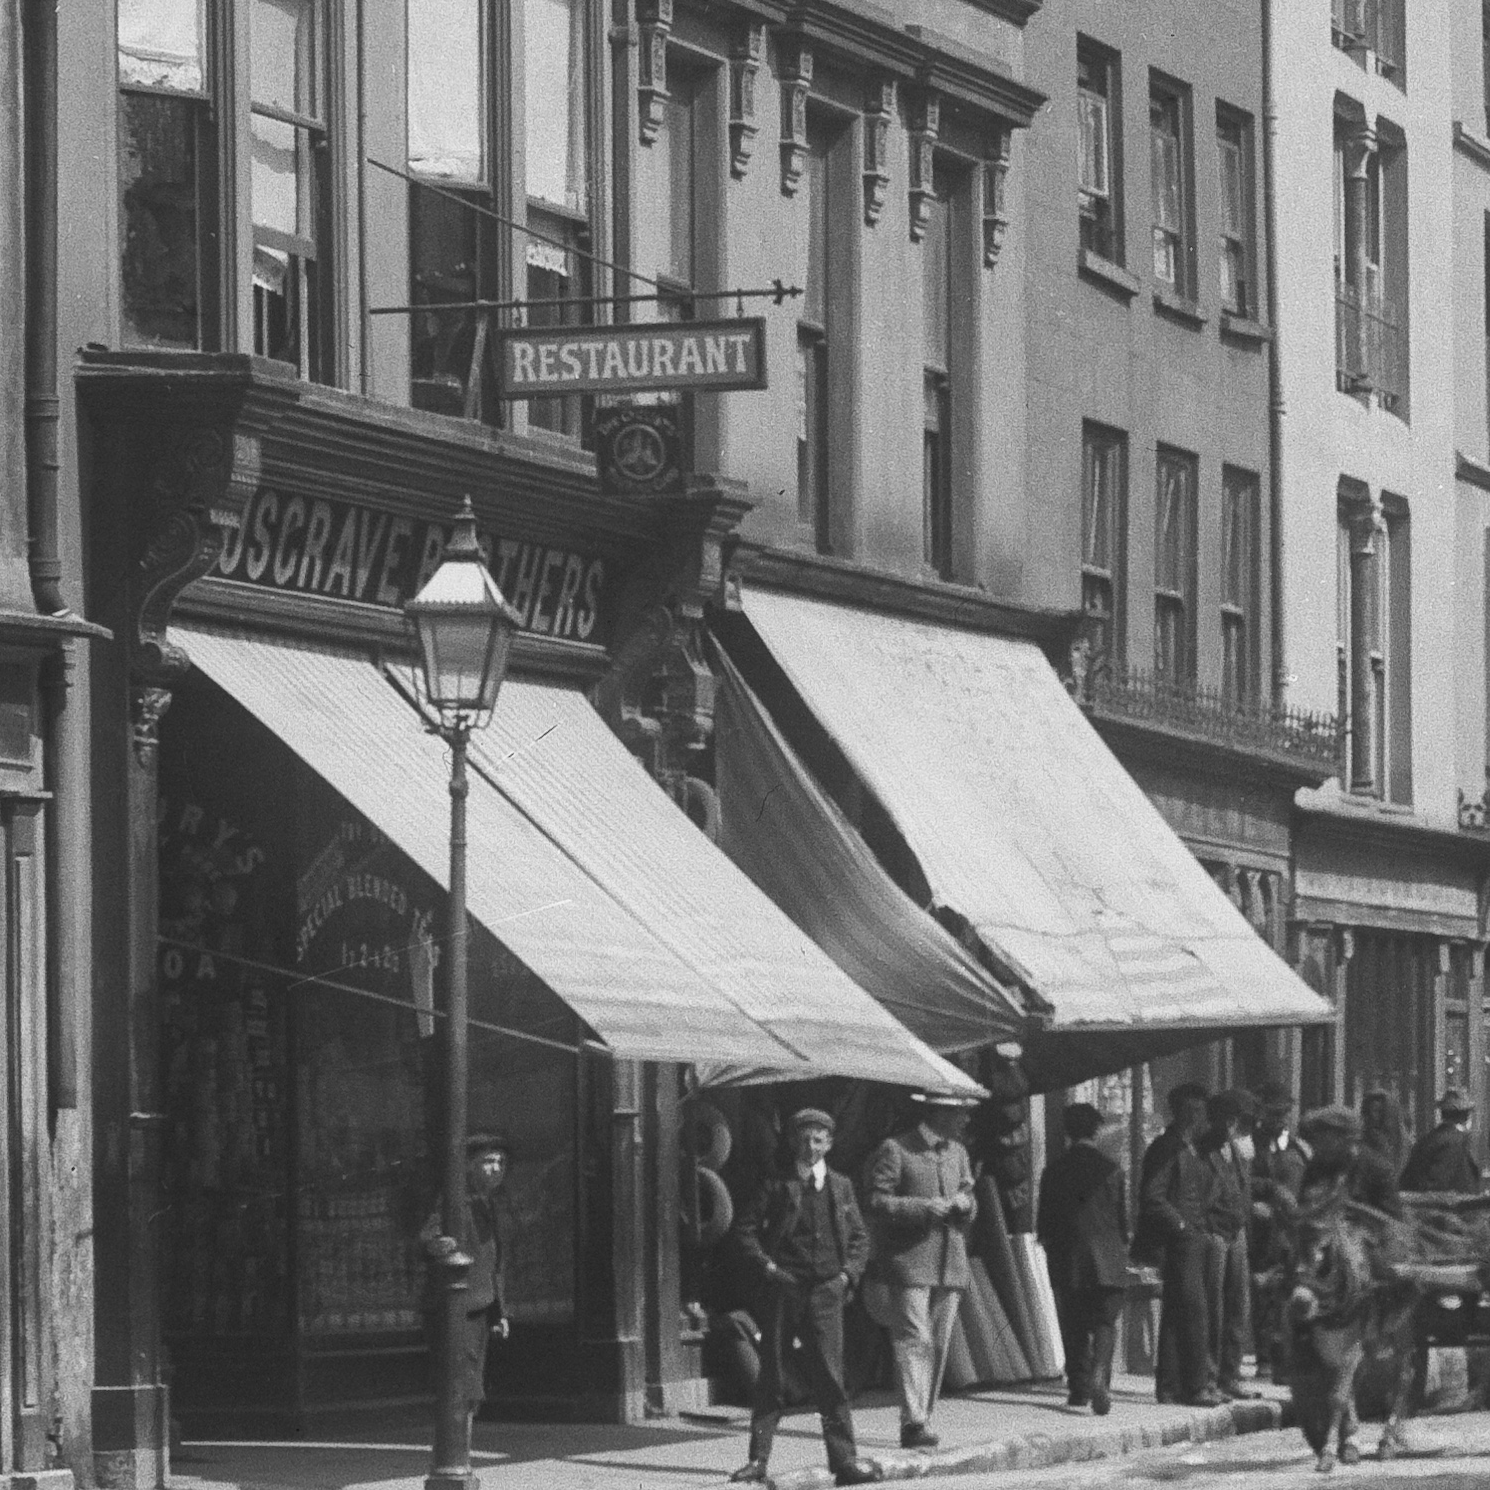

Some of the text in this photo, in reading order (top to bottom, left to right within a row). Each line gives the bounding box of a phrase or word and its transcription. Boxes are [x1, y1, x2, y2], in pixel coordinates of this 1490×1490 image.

[512, 333, 751, 383] RESTAURANT
[218, 490, 605, 640] USGRAVE BTHERS
